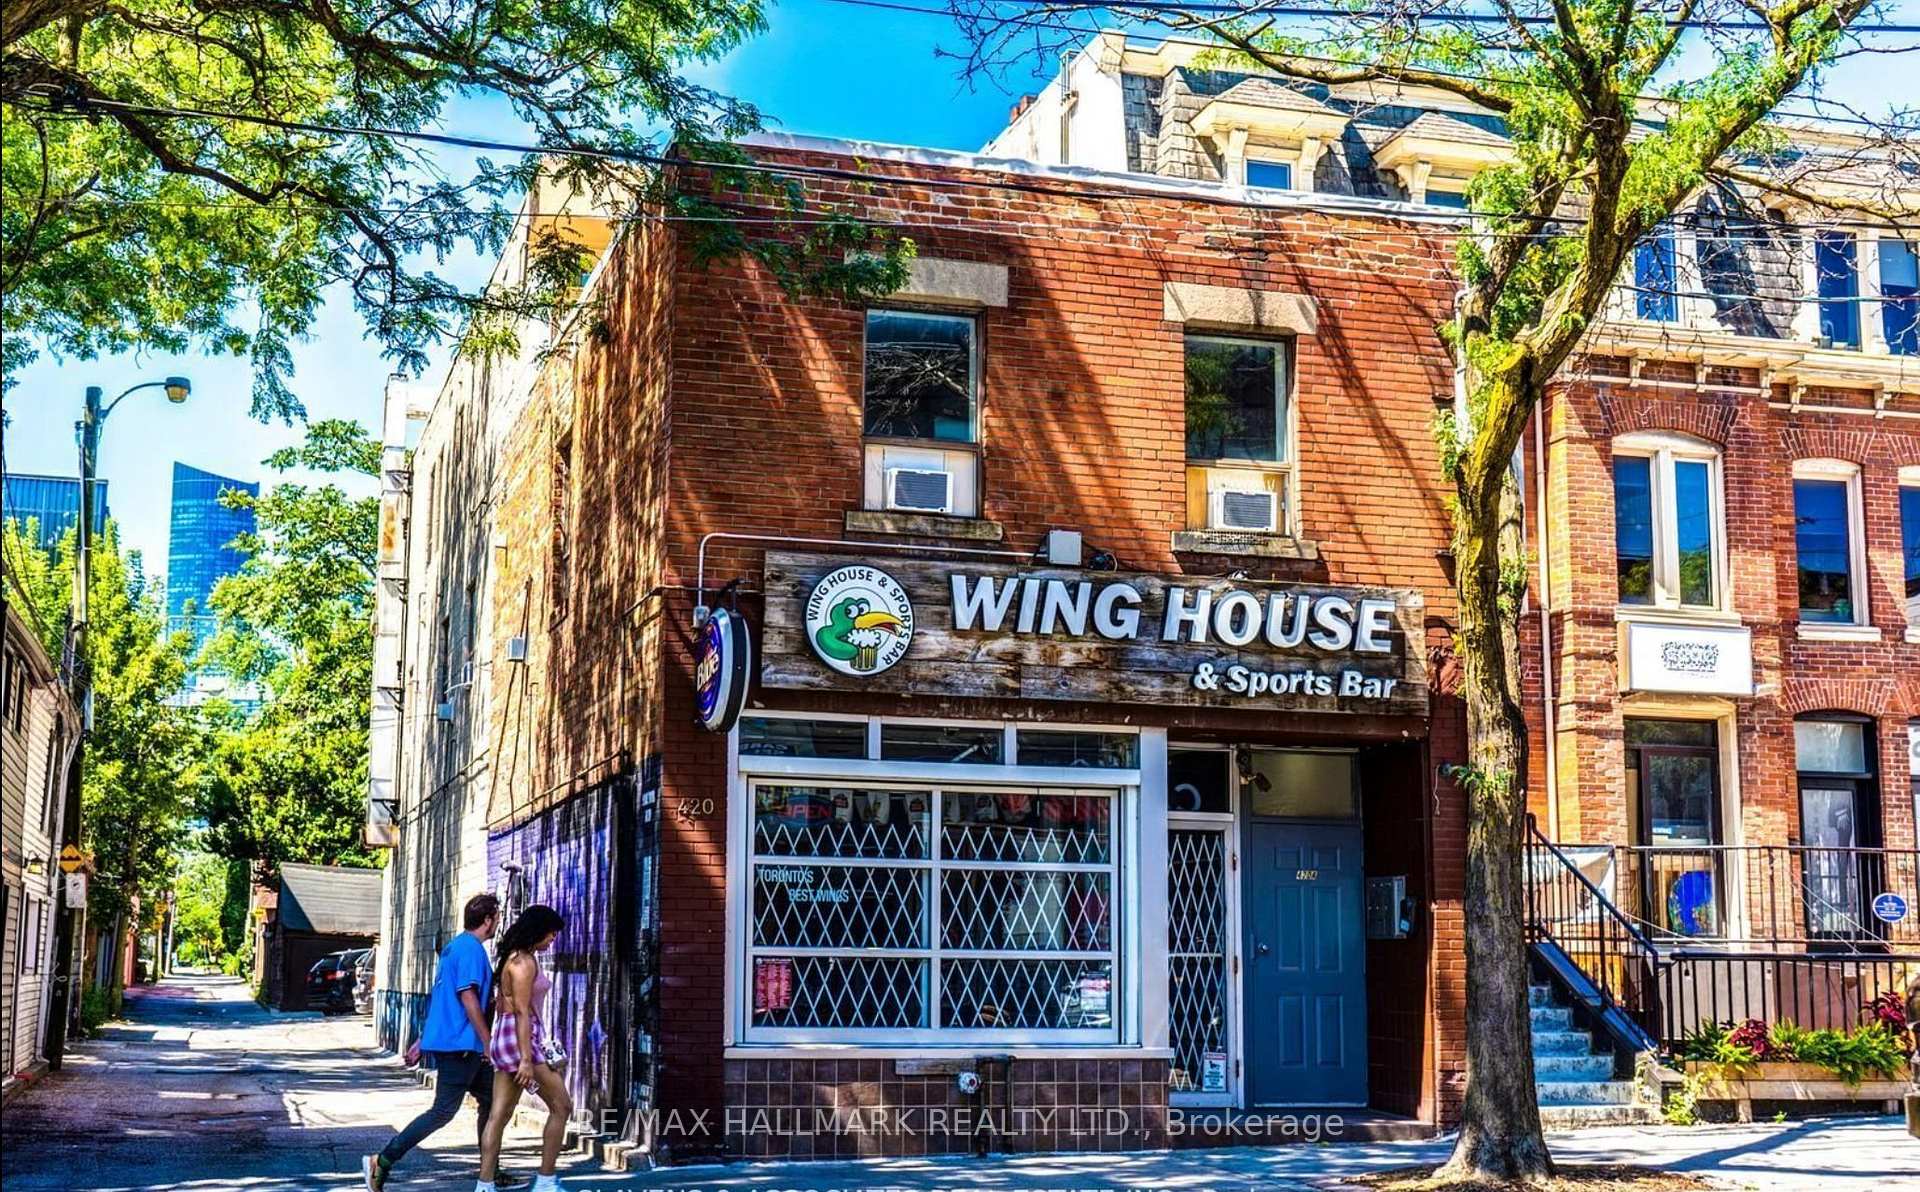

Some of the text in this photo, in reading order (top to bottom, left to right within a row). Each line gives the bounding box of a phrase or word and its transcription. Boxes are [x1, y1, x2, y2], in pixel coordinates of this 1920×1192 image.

[808, 569, 911, 666] WING HOUSE & SPORTS BAR
[949, 574, 1397, 653] WING HOUSE
[1193, 663, 1397, 699] & Sports Bar
[678, 797, 714, 815] 420
[788, 888, 849, 903] BEST WINGS
